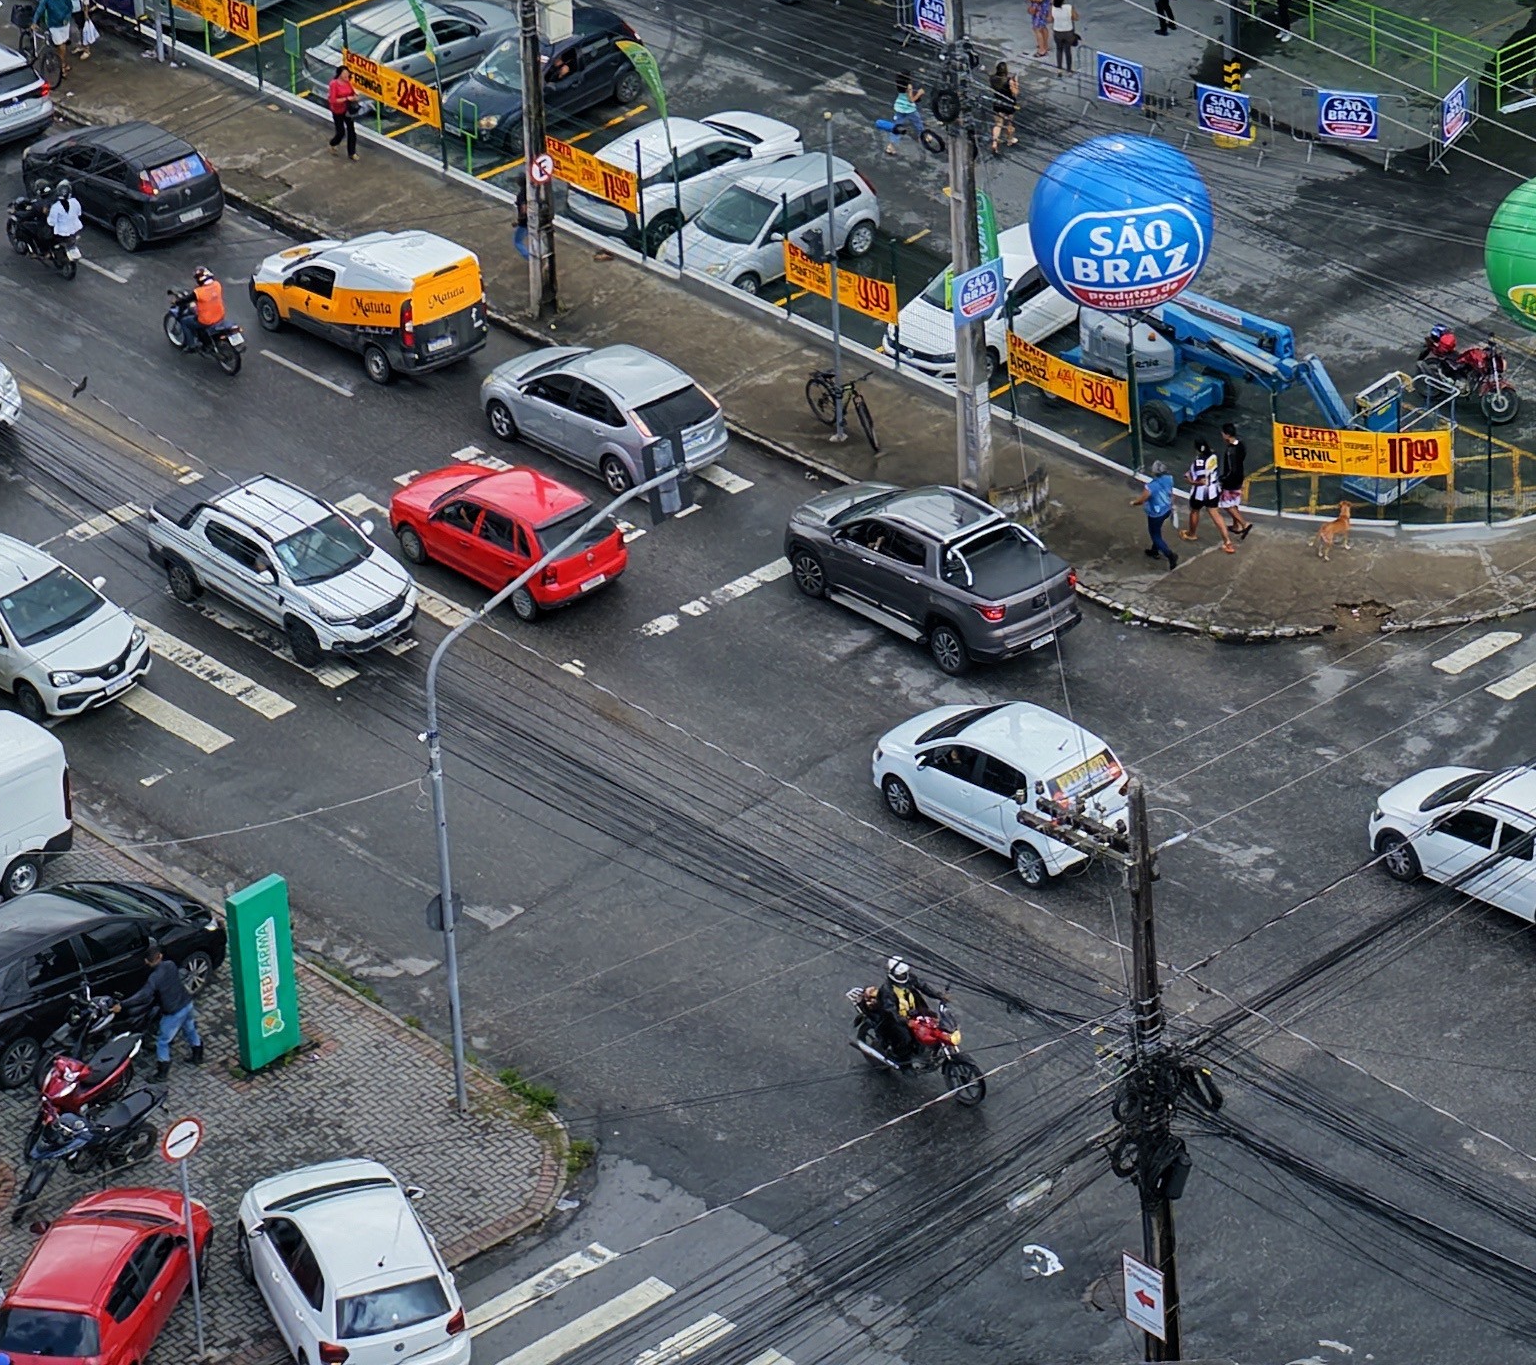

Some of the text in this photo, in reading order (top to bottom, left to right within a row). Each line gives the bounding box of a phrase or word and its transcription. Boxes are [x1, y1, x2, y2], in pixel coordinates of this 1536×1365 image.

[1109, 63, 1131, 79] SÃO
[1105, 72, 1136, 91] BRAZ
[1205, 103, 1241, 120] BRAZ
[1210, 95, 1234, 111] SÃO
[1333, 98, 1362, 111] SÃO
[1327, 111, 1368, 122] BRAZ
[1091, 218, 1172, 256] SÃO
[1072, 244, 1190, 283] BRAZ
[967, 273, 990, 291] SÃO
[1087, 280, 1178, 302] produtos de
[963, 281, 994, 303] BRAZ
[353, 296, 392, 318] Matuta
[1009, 351, 1049, 382] ARROZ
[1283, 447, 1337, 464] PERNIL
[260, 926, 275, 1008] MEDFARMA
